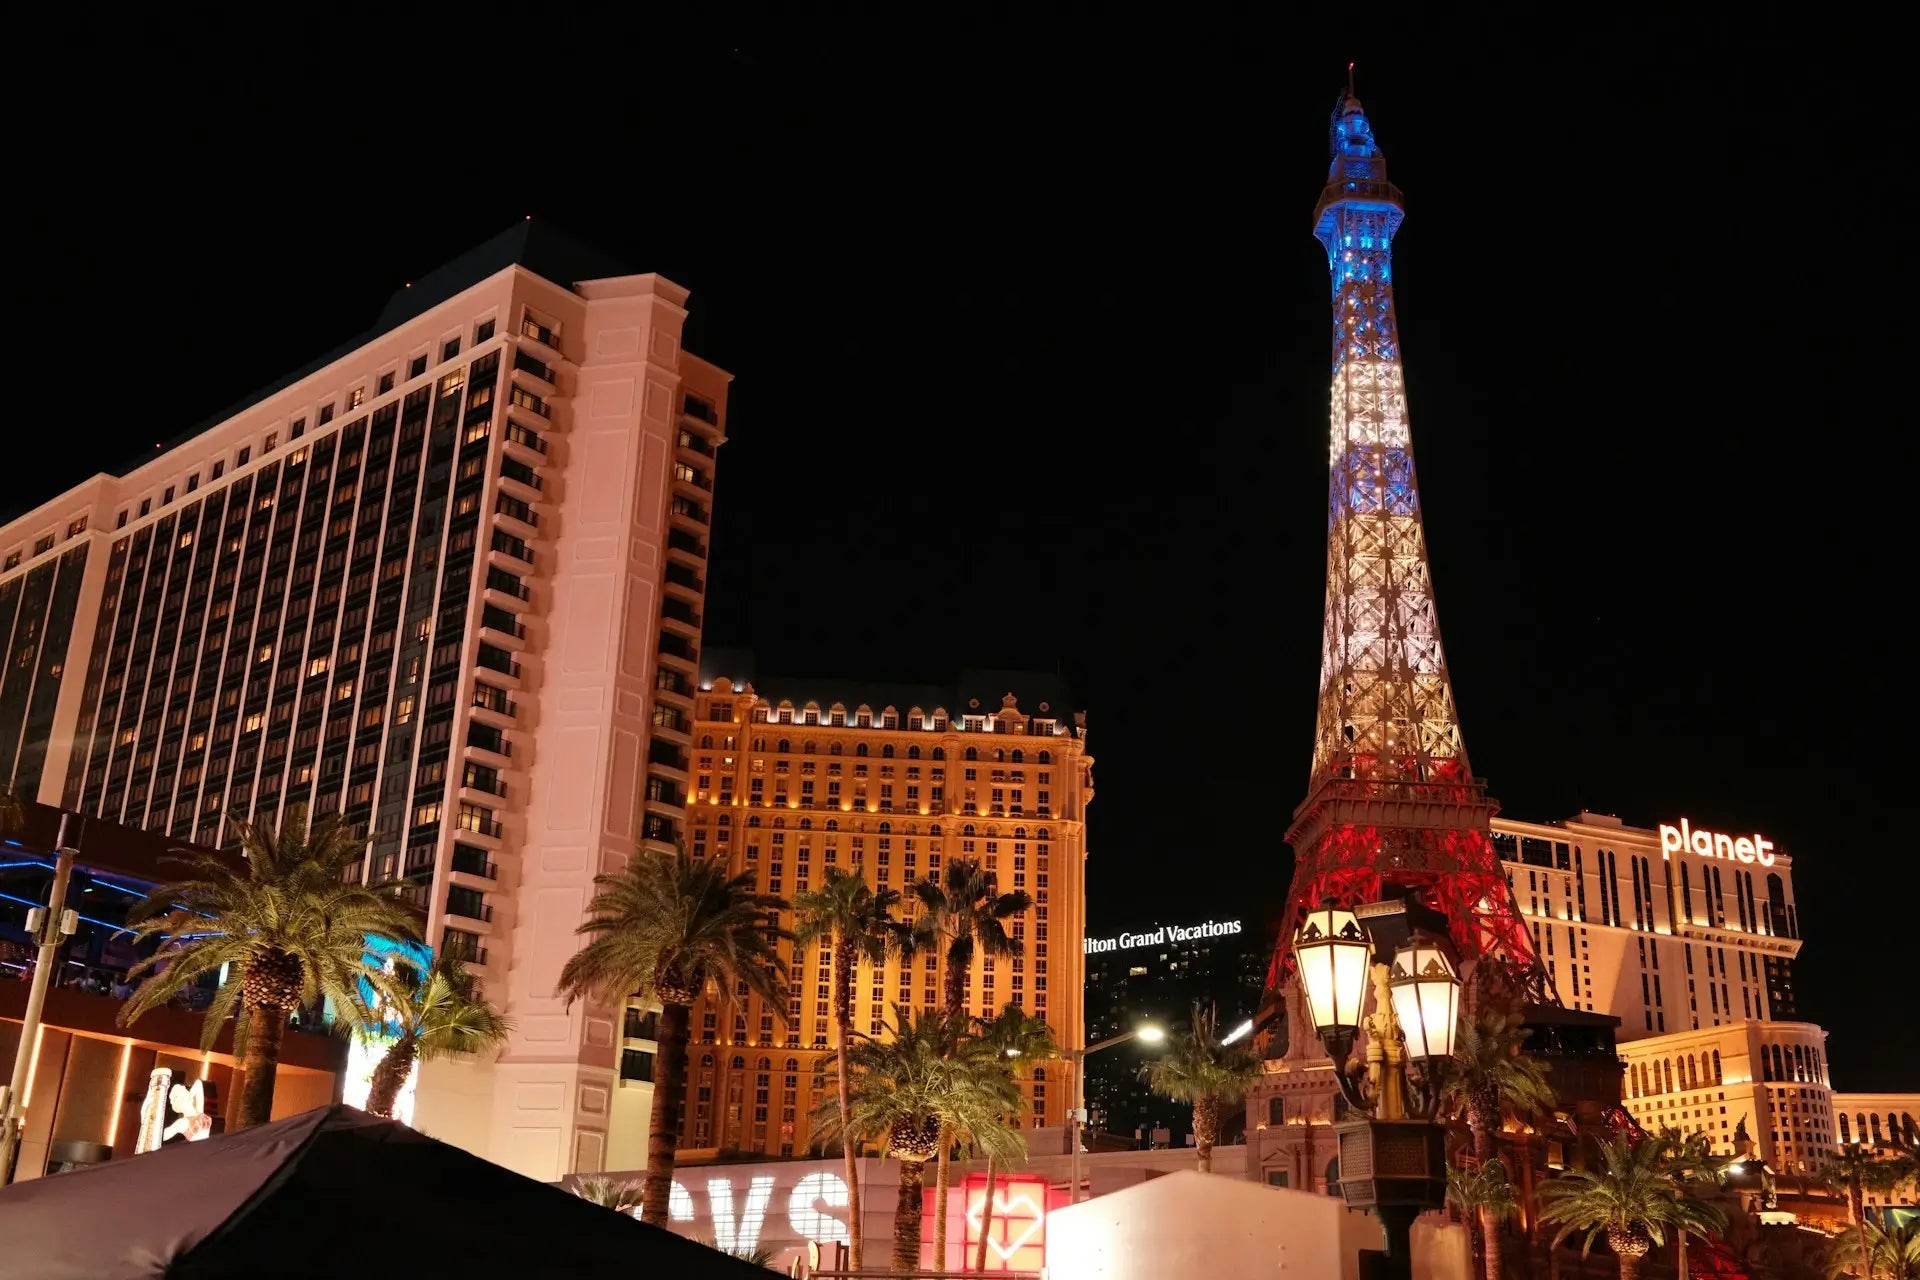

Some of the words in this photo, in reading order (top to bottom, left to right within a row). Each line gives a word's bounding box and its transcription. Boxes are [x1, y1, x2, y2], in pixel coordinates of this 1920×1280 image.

[1660, 817, 1775, 867] planet
[1083, 937, 1117, 954] ilton
[1119, 927, 1165, 949] Grand
[1166, 919, 1242, 943] Vacations
